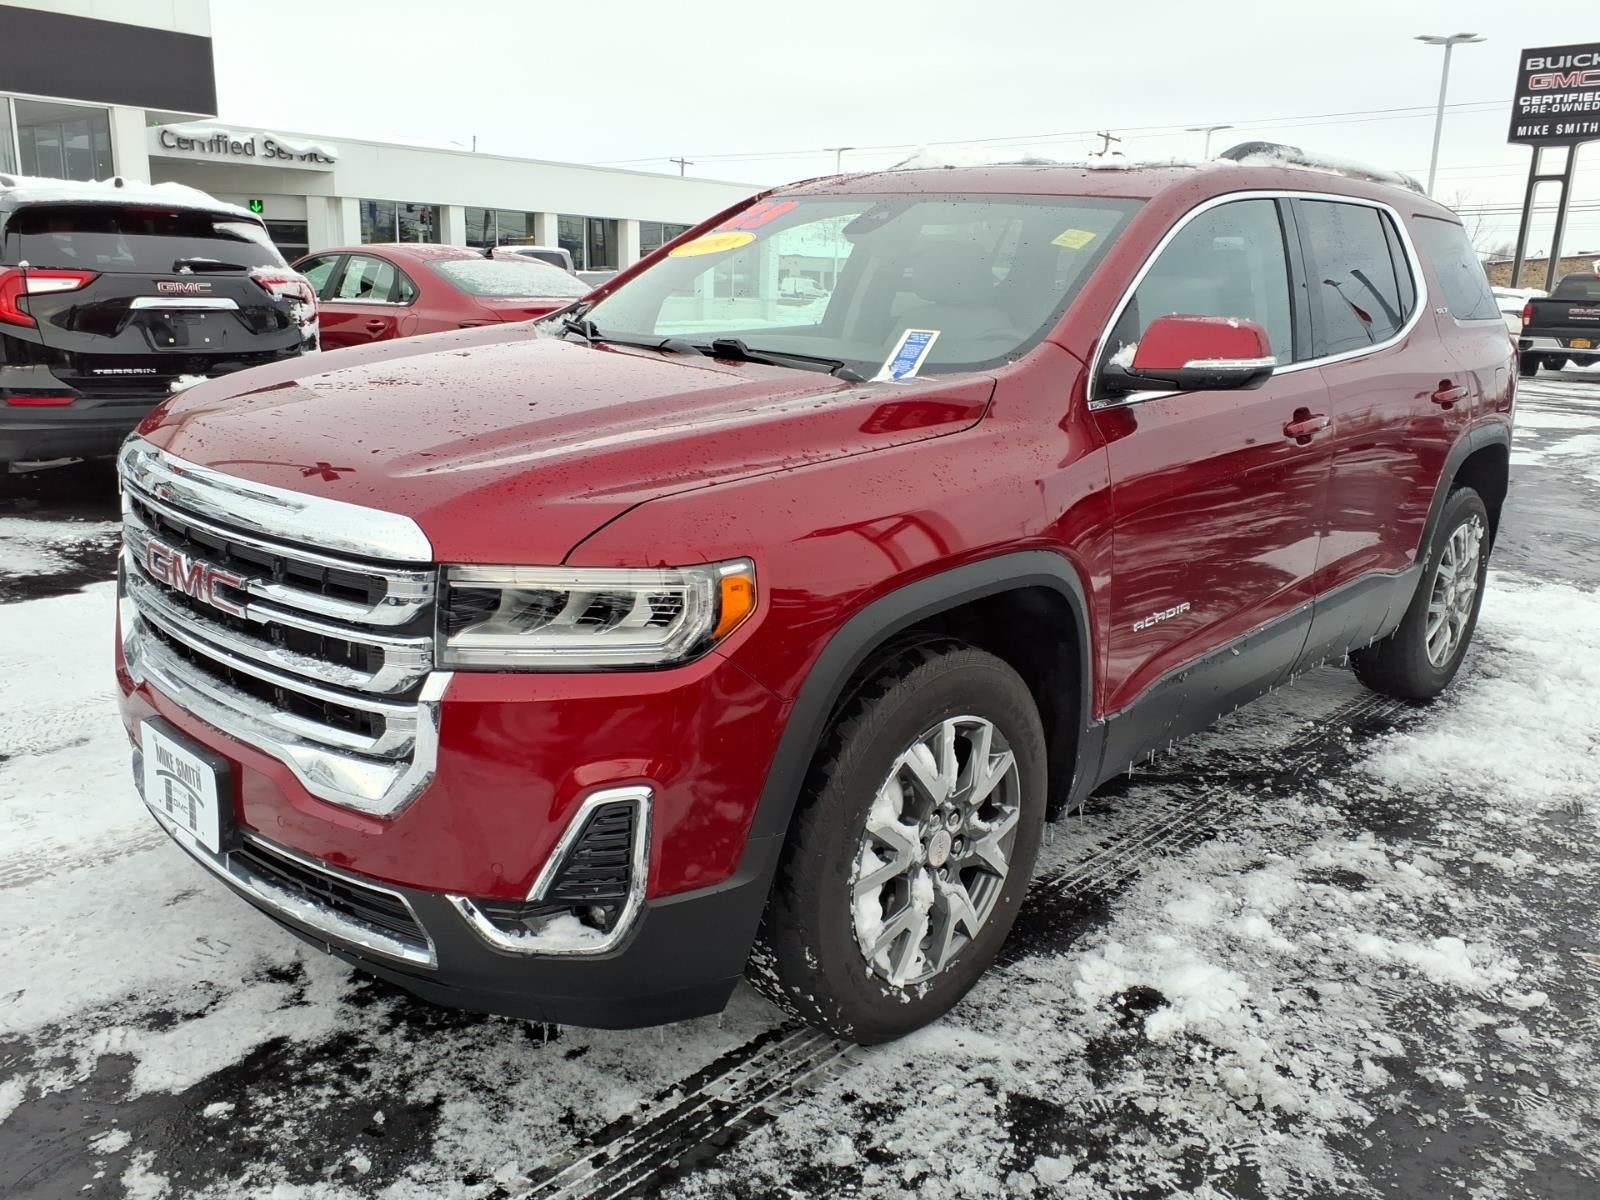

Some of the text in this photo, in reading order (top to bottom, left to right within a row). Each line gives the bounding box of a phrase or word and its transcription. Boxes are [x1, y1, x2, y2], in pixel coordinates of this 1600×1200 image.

[1529, 69, 1600, 90] GMC
[1522, 101, 1600, 114] PRE-OWNED
[1517, 122, 1599, 136] MIKE SMITH
[157, 282, 212, 293] GMC
[146, 539, 247, 618] GMC
[1133, 602, 1190, 632] ACADIA
[155, 743, 175, 773] MIKE
[175, 757, 202, 792] SMITH
